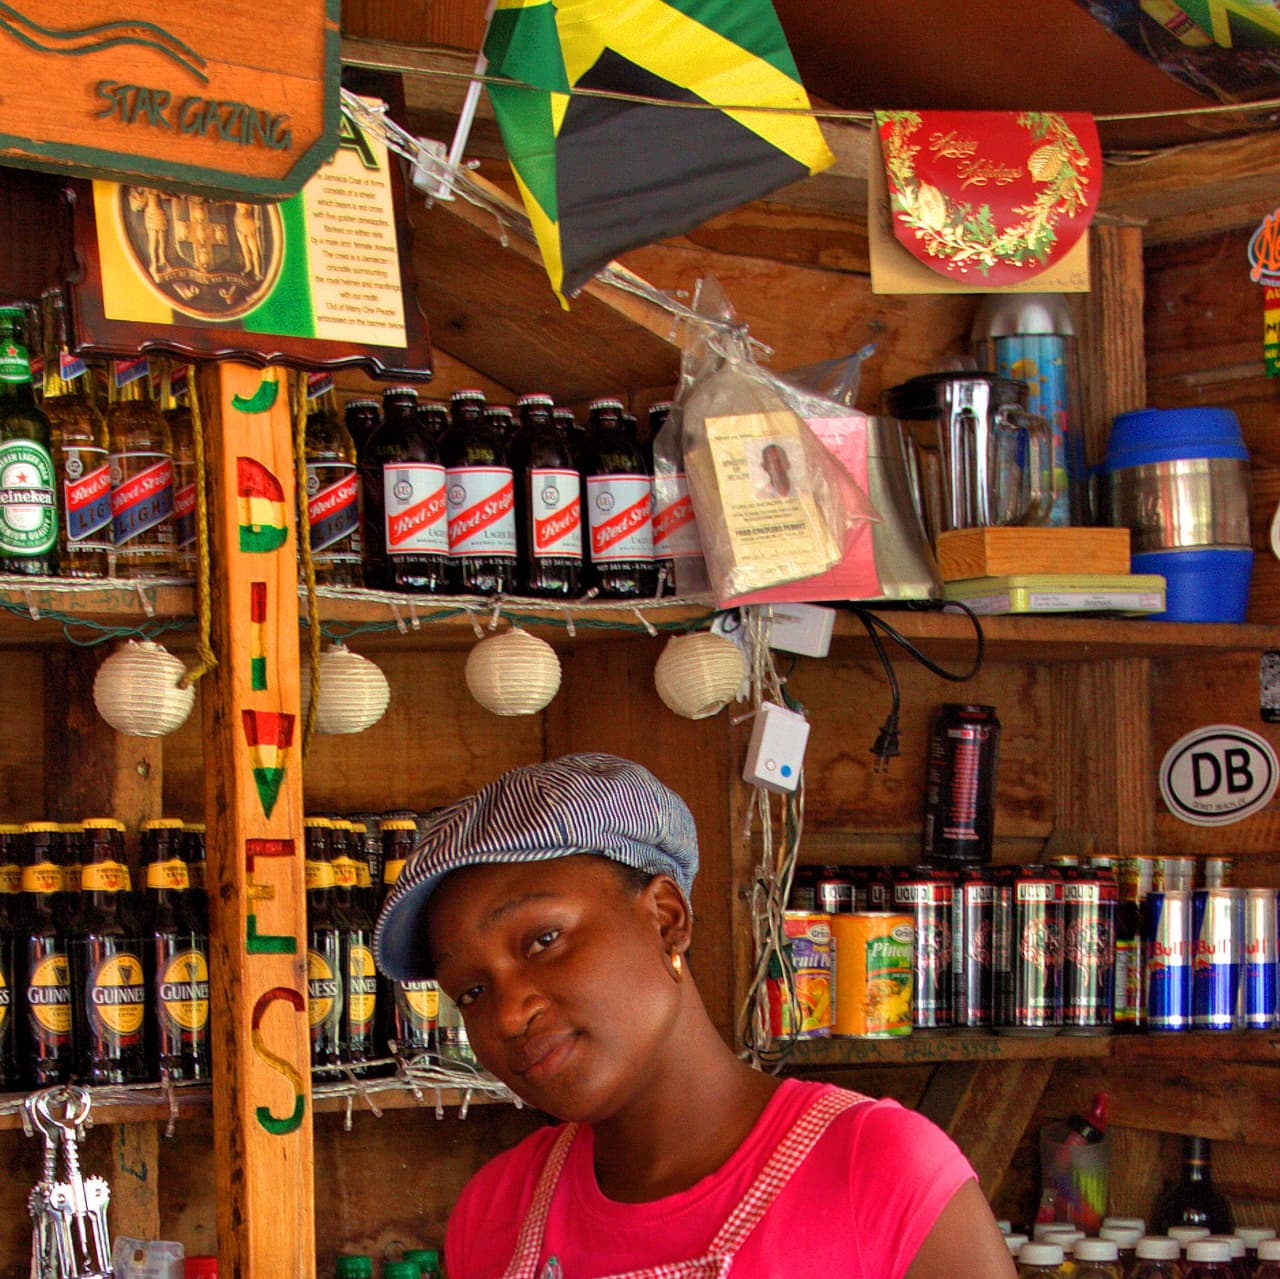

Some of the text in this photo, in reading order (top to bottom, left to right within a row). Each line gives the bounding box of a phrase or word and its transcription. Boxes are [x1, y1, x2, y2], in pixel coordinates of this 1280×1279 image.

[96, 79, 170, 128] STAR
[179, 95, 293, 150] GAZING
[393, 513, 421, 534] Red
[451, 515, 481, 540] Red
[1191, 748, 1254, 797] DB
